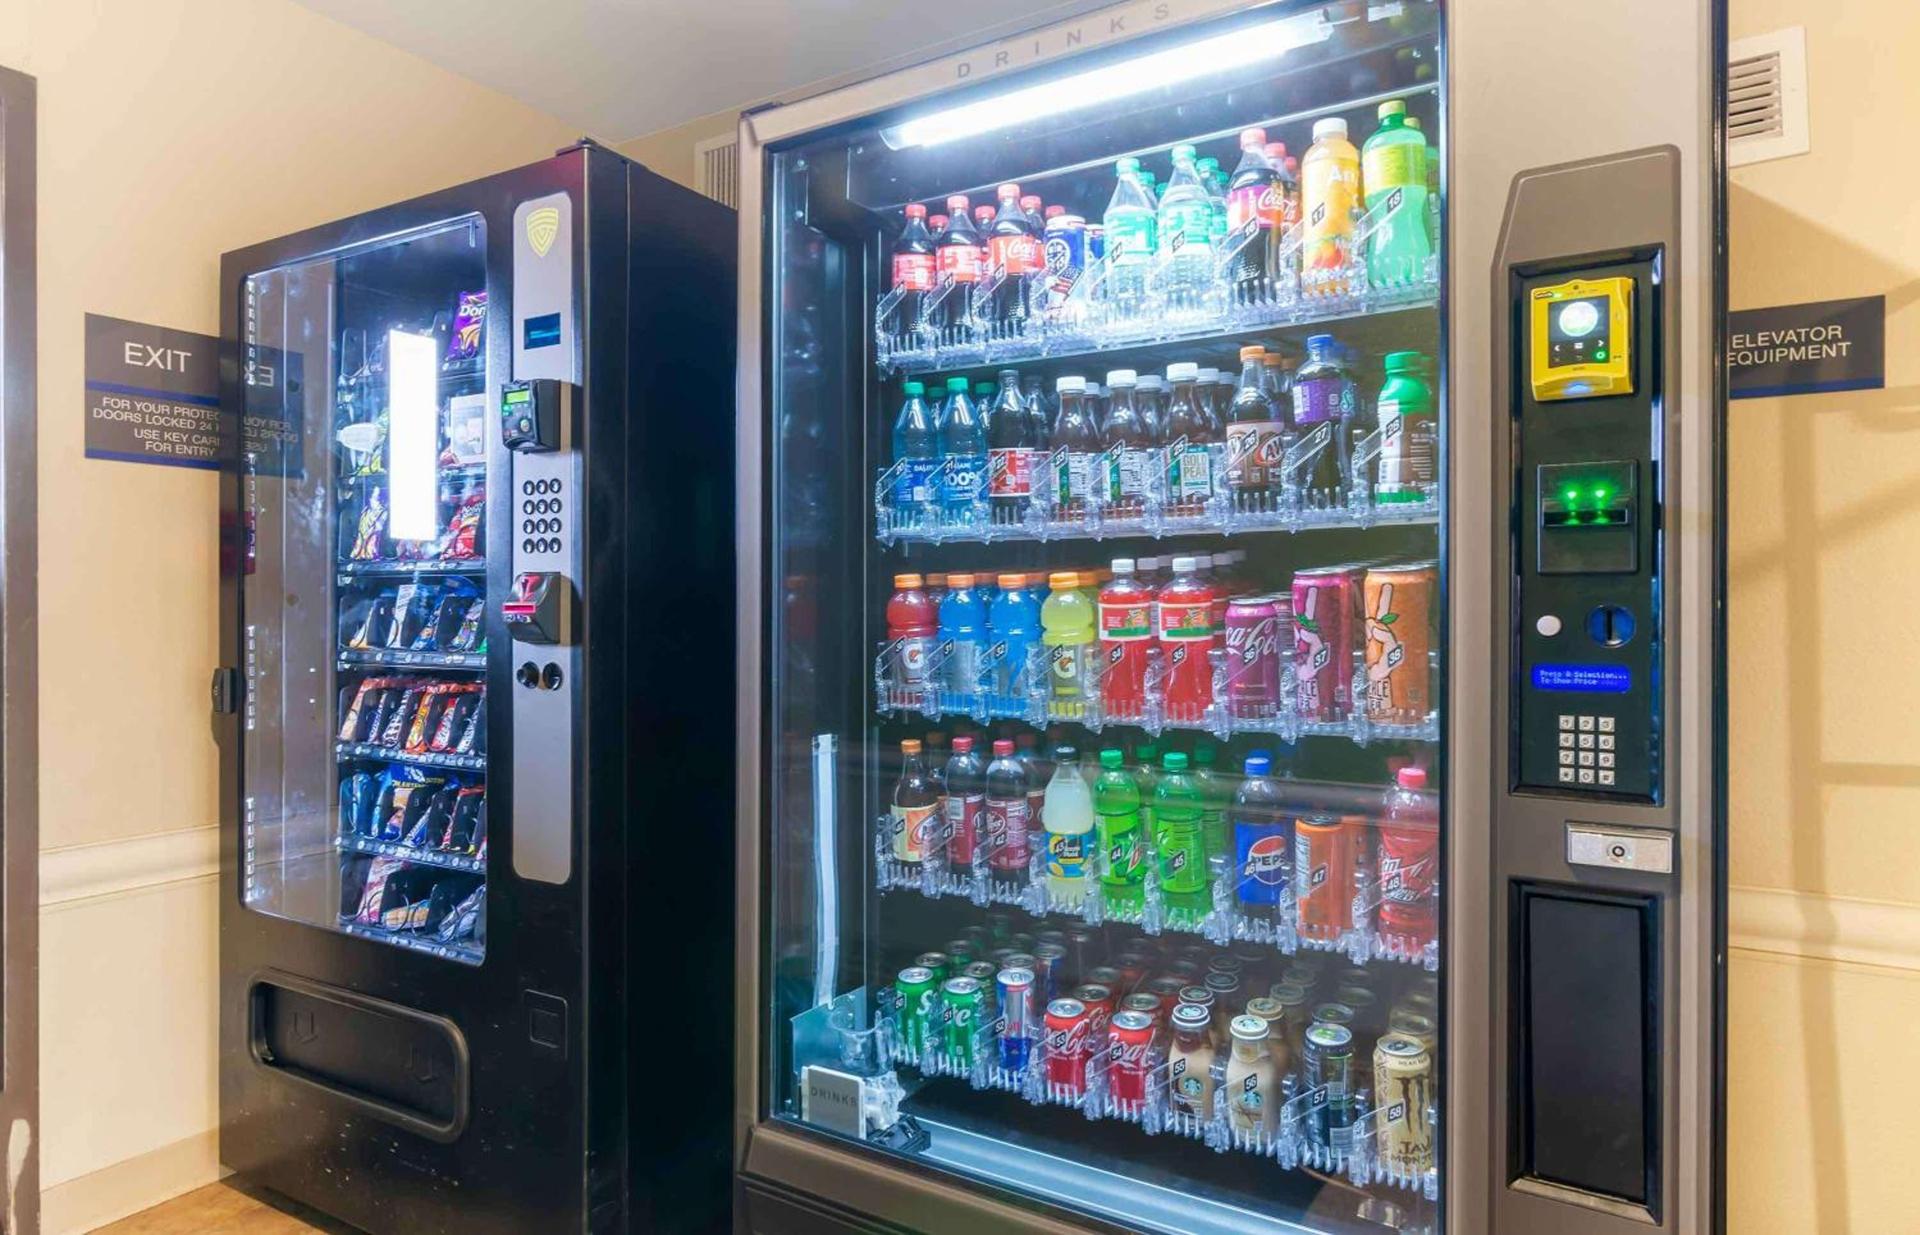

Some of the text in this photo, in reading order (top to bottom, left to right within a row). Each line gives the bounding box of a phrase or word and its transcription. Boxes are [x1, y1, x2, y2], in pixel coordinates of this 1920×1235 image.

[957, 3, 1170, 79] DRINKS
[1732, 325, 1842, 349] ELEVATOR
[124, 342, 192, 373] EXIT
[1727, 341, 1852, 367] EQUIPMENT
[102, 396, 131, 410] FOR
[134, 401, 171, 415] YOUR
[93, 408, 142, 423] DOORS
[145, 414, 196, 430] LOCKED
[199, 421, 213, 431] 24
[134, 428, 160, 440] USE
[164, 432, 189, 444] KEY
[145, 441, 215, 457] FOR ENTRY
[944, 1010, 953, 1022] 51
[995, 1020, 1005, 1033] 52
[1056, 1034, 1066, 1047] 53
[1174, 1060, 1185, 1074] 55
[1245, 1075, 1257, 1090] 56
[810, 1086, 857, 1107] DRINKS
[1313, 1090, 1326, 1104] 57
[1389, 1106, 1402, 1120] 58
